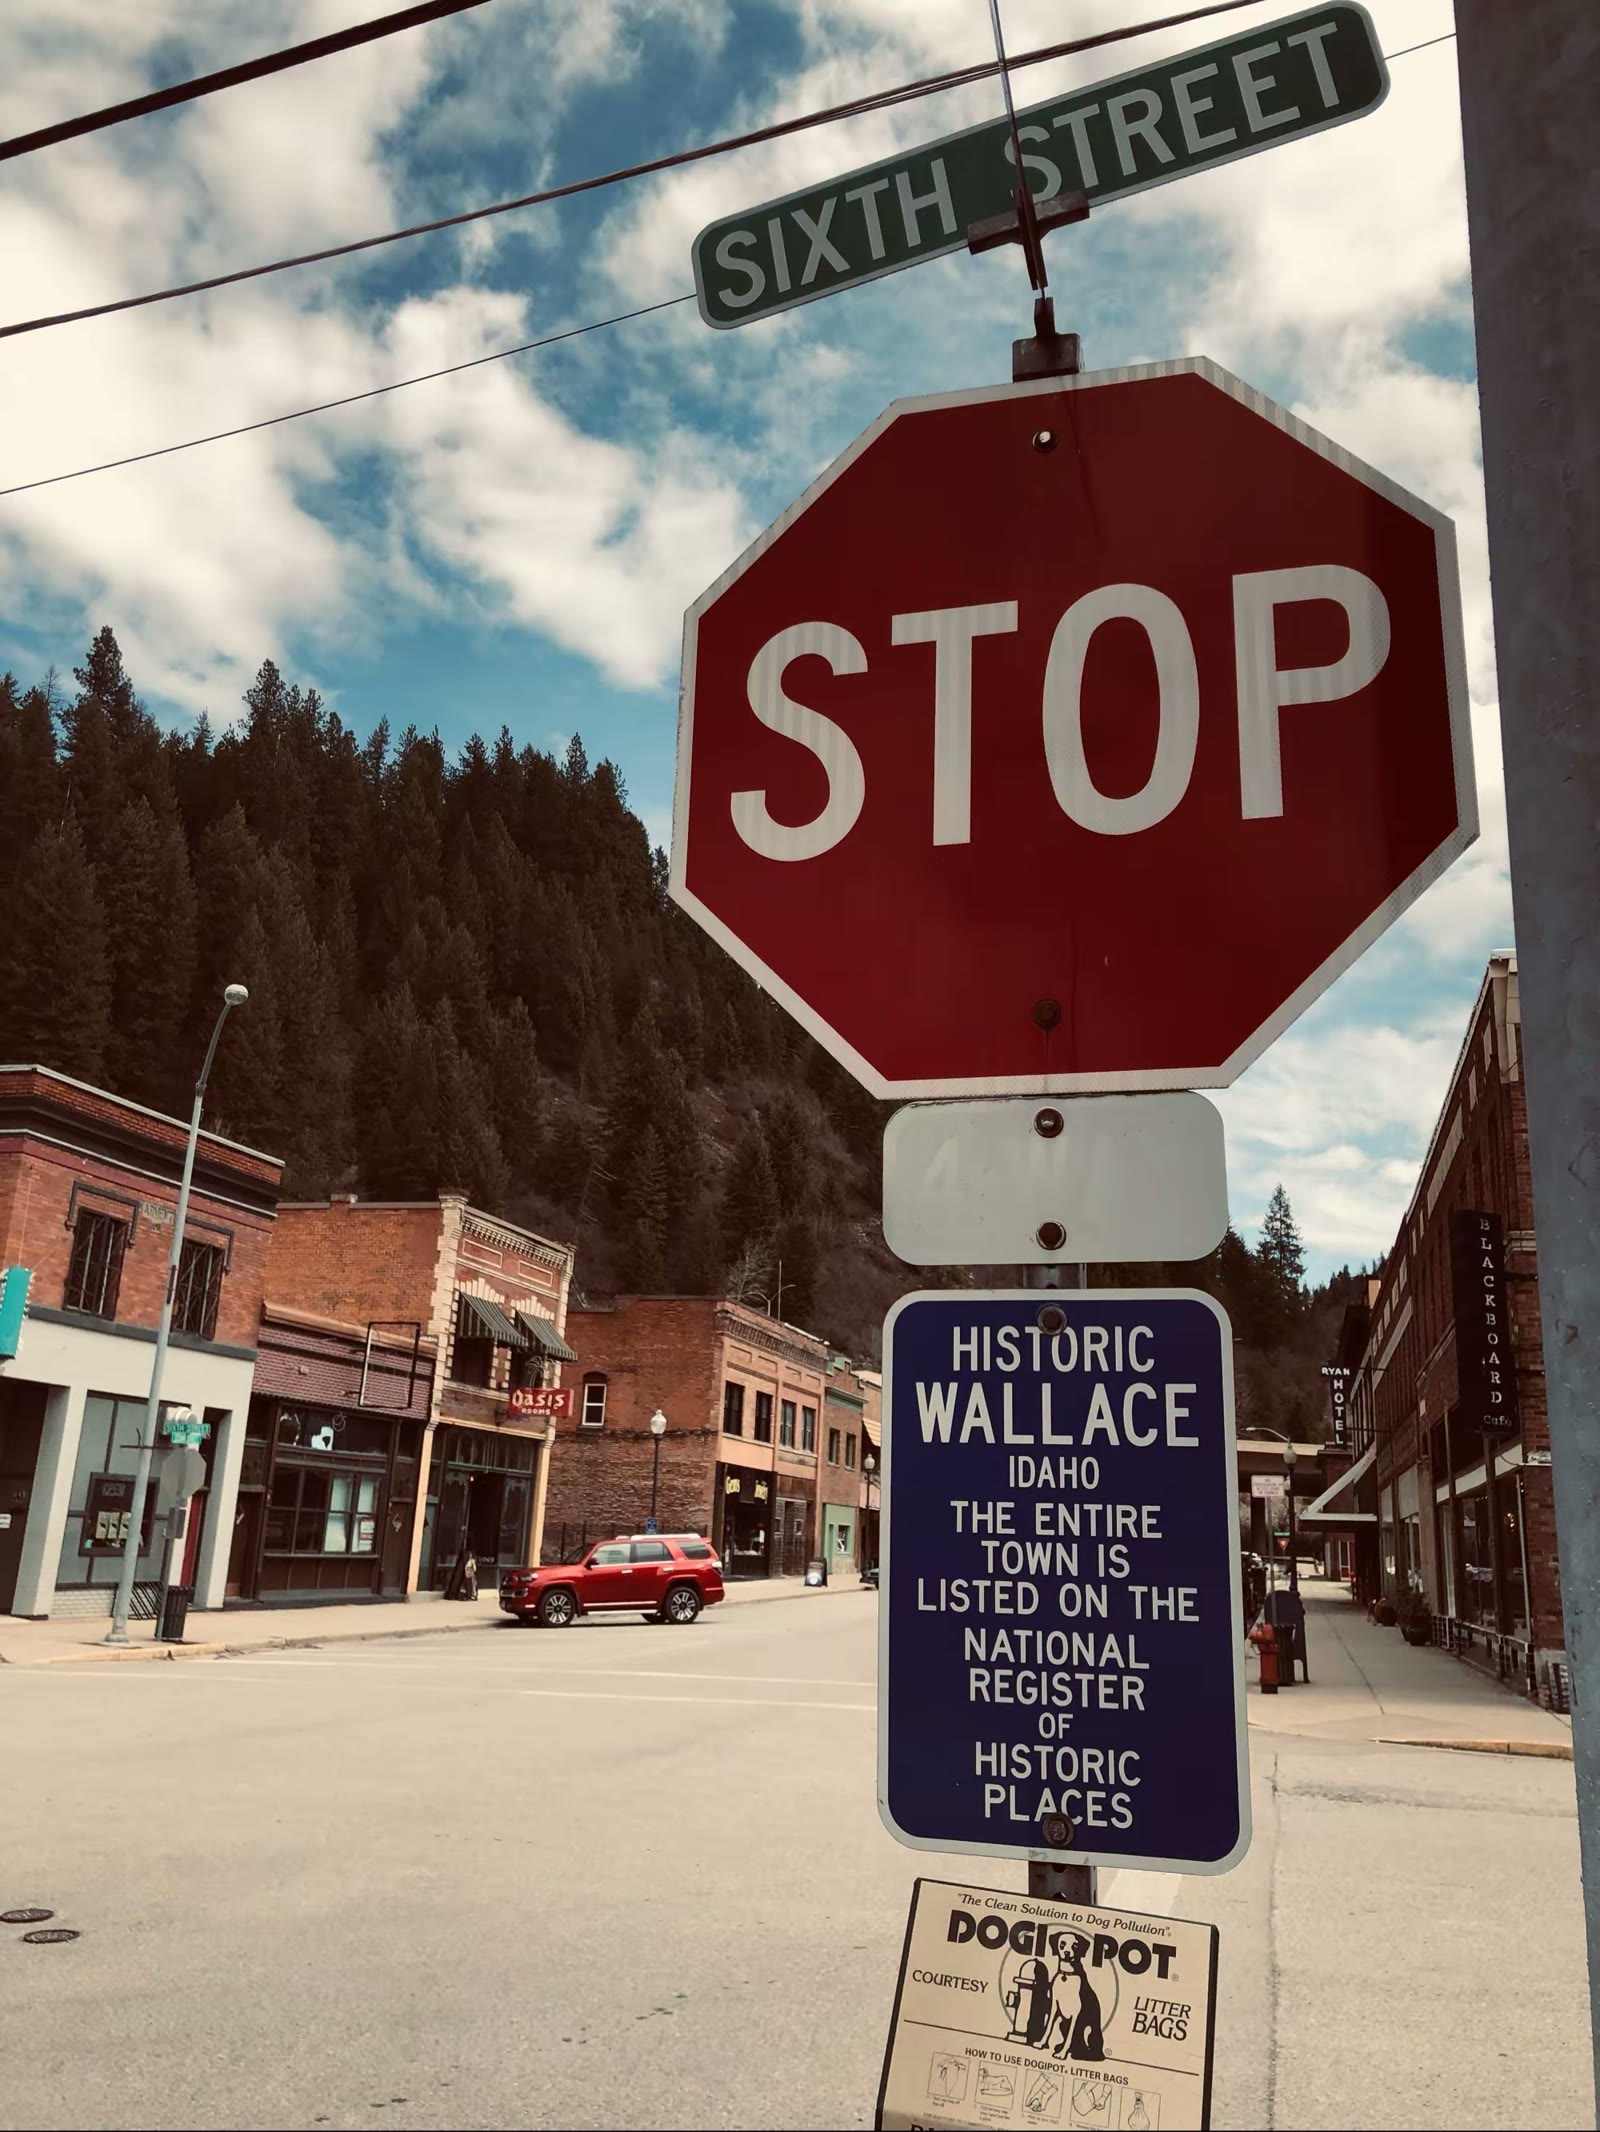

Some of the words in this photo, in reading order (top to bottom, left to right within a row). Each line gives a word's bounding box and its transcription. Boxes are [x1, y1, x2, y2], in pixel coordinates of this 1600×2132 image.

[714, 157, 960, 309] SIXTH
[1002, 20, 1342, 202] STREET
[730, 563, 1393, 862] STOP
[1478, 1217, 1503, 1404] BLACKBOARD
[952, 1325, 1155, 1373] HISTORIC
[1321, 1366, 1351, 1376] RYAN
[511, 1388, 567, 1410] Oasis
[521, 1407, 551, 1416] ROOMS
[915, 1381, 1200, 1448] WALLACE
[1333, 1378, 1345, 1445] HOTEL
[1008, 1455, 1100, 1490] IDAHO
[949, 1500, 1017, 1535] THE
[1034, 1502, 1164, 1539] ENTIRE
[980, 1540, 1079, 1577] TOWN
[1098, 1543, 1131, 1579] IS
[917, 1577, 1040, 1616] LISTED
[1058, 1582, 1109, 1619] ON
[1127, 1585, 1200, 1623] THE
[963, 1626, 1151, 1670] NATIONAL
[969, 1667, 1146, 1711] REGISTER
[1038, 1711, 1074, 1739] OF
[974, 1741, 1142, 1787] HISTORIC
[983, 1782, 1134, 1829] PLACES
[957, 1892, 982, 1907] "The
[984, 1897, 1018, 1913] Clean
[1020, 1903, 1069, 1921] Solution
[1071, 1913, 1083, 1924] to
[1086, 1913, 1110, 1930] Dog
[911, 1968, 989, 1994] COURTESY
[1131, 2012, 1189, 2042] BAGS
[1133, 1995, 1193, 2021] LITTER
[964, 2047, 988, 2060] HOW
[989, 2051, 1002, 2062] TO
[1003, 2053, 1022, 2066] USE
[1070, 2067, 1101, 2081] LITTER
[1103, 2072, 1130, 2086] BAGS
